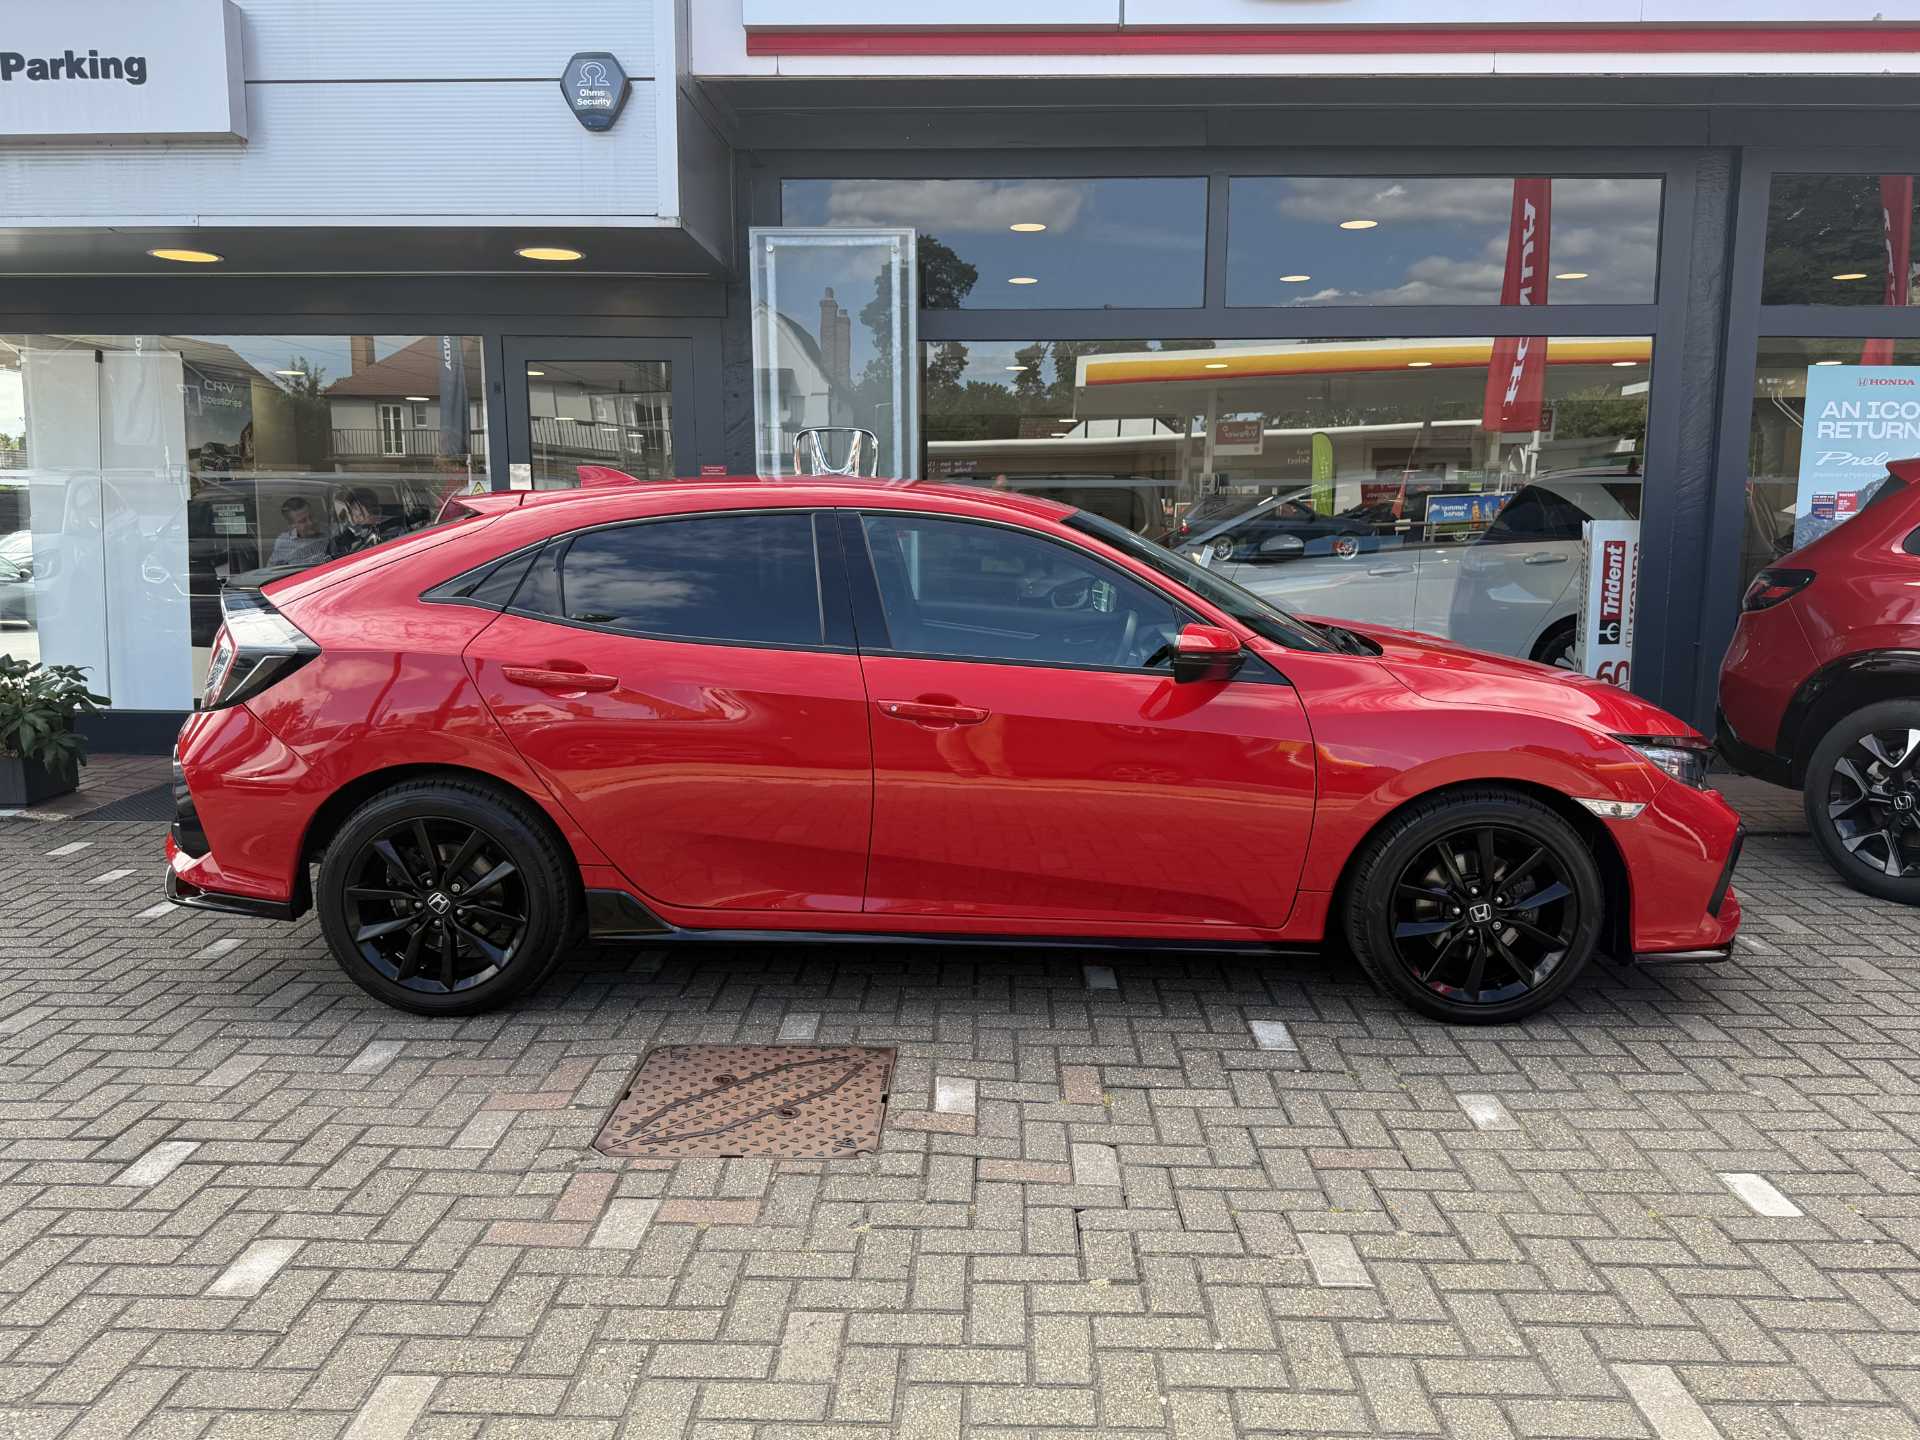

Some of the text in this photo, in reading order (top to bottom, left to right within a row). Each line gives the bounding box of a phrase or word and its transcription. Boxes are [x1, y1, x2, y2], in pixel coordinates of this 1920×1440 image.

[0, 50, 147, 85] Parking
[580, 89, 606, 97] Ohms
[577, 98, 611, 106] Security
[1870, 378, 1915, 386] HONDA
[1820, 401, 1861, 419] AN
[1815, 451, 1890, 467] Prel
[1603, 544, 1623, 617] Trident
